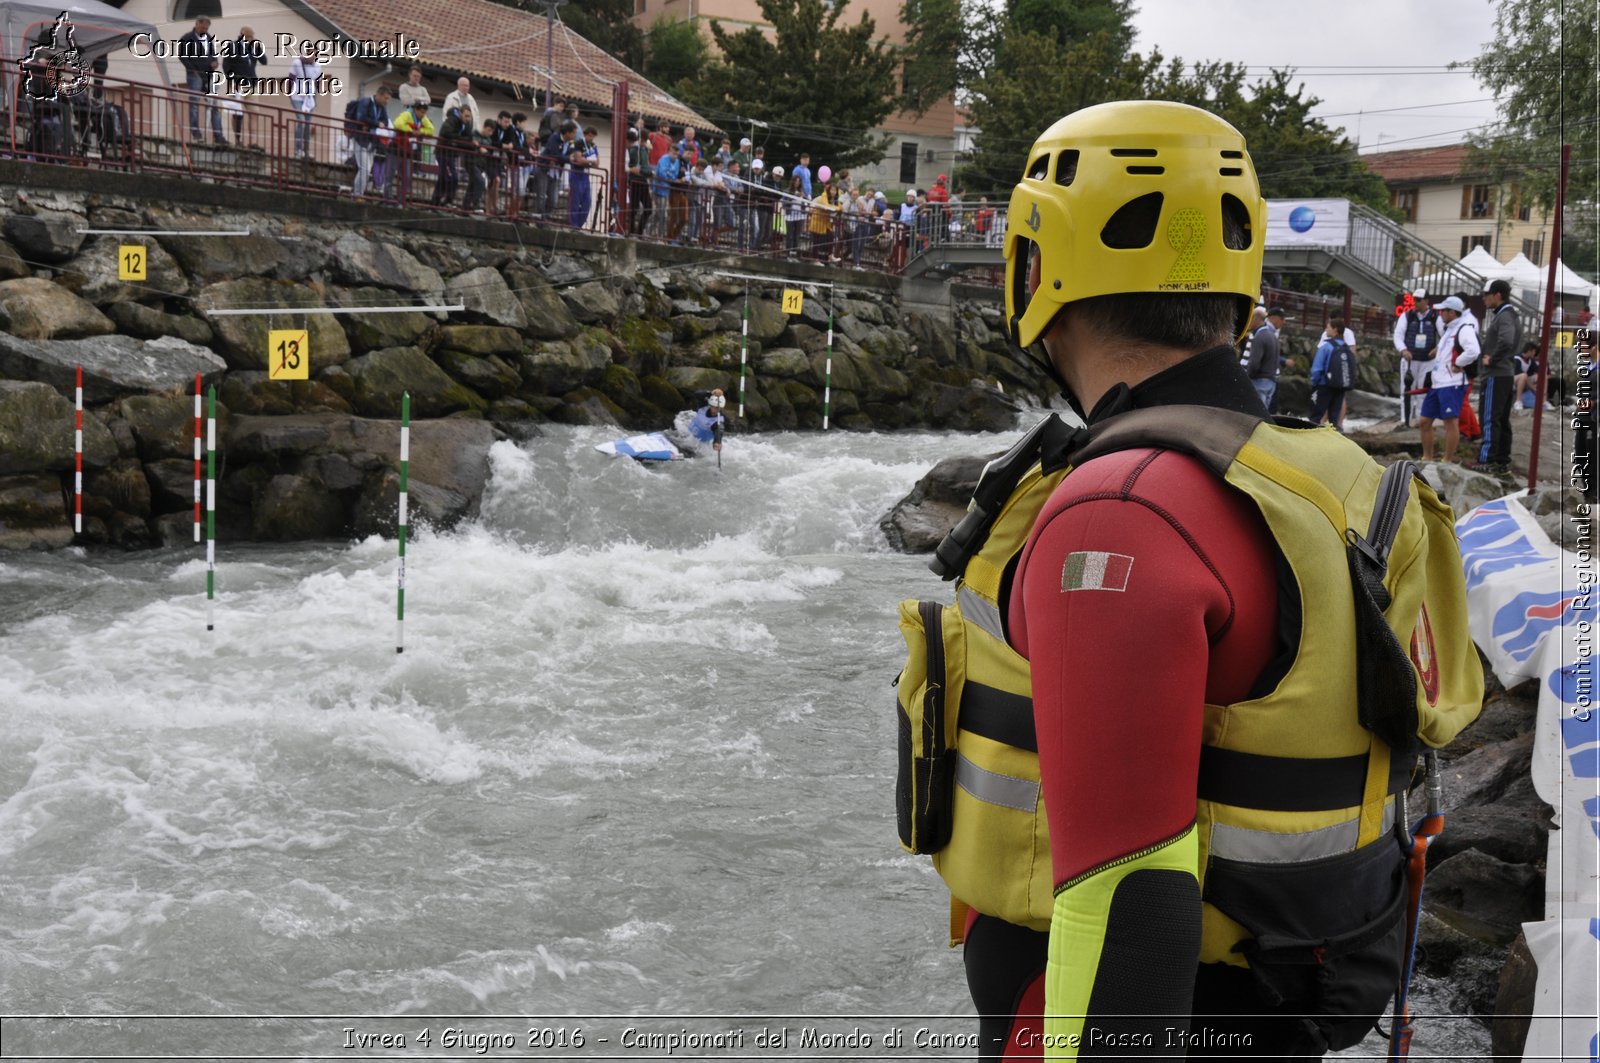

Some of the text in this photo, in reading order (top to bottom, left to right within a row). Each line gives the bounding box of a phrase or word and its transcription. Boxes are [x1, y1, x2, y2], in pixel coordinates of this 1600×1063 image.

[1165, 208, 1208, 281] 2
[124, 253, 141, 273] 12
[1158, 281, 1210, 291] MONCALIERI
[788, 295, 799, 309] 11
[277, 340, 301, 370] 13
